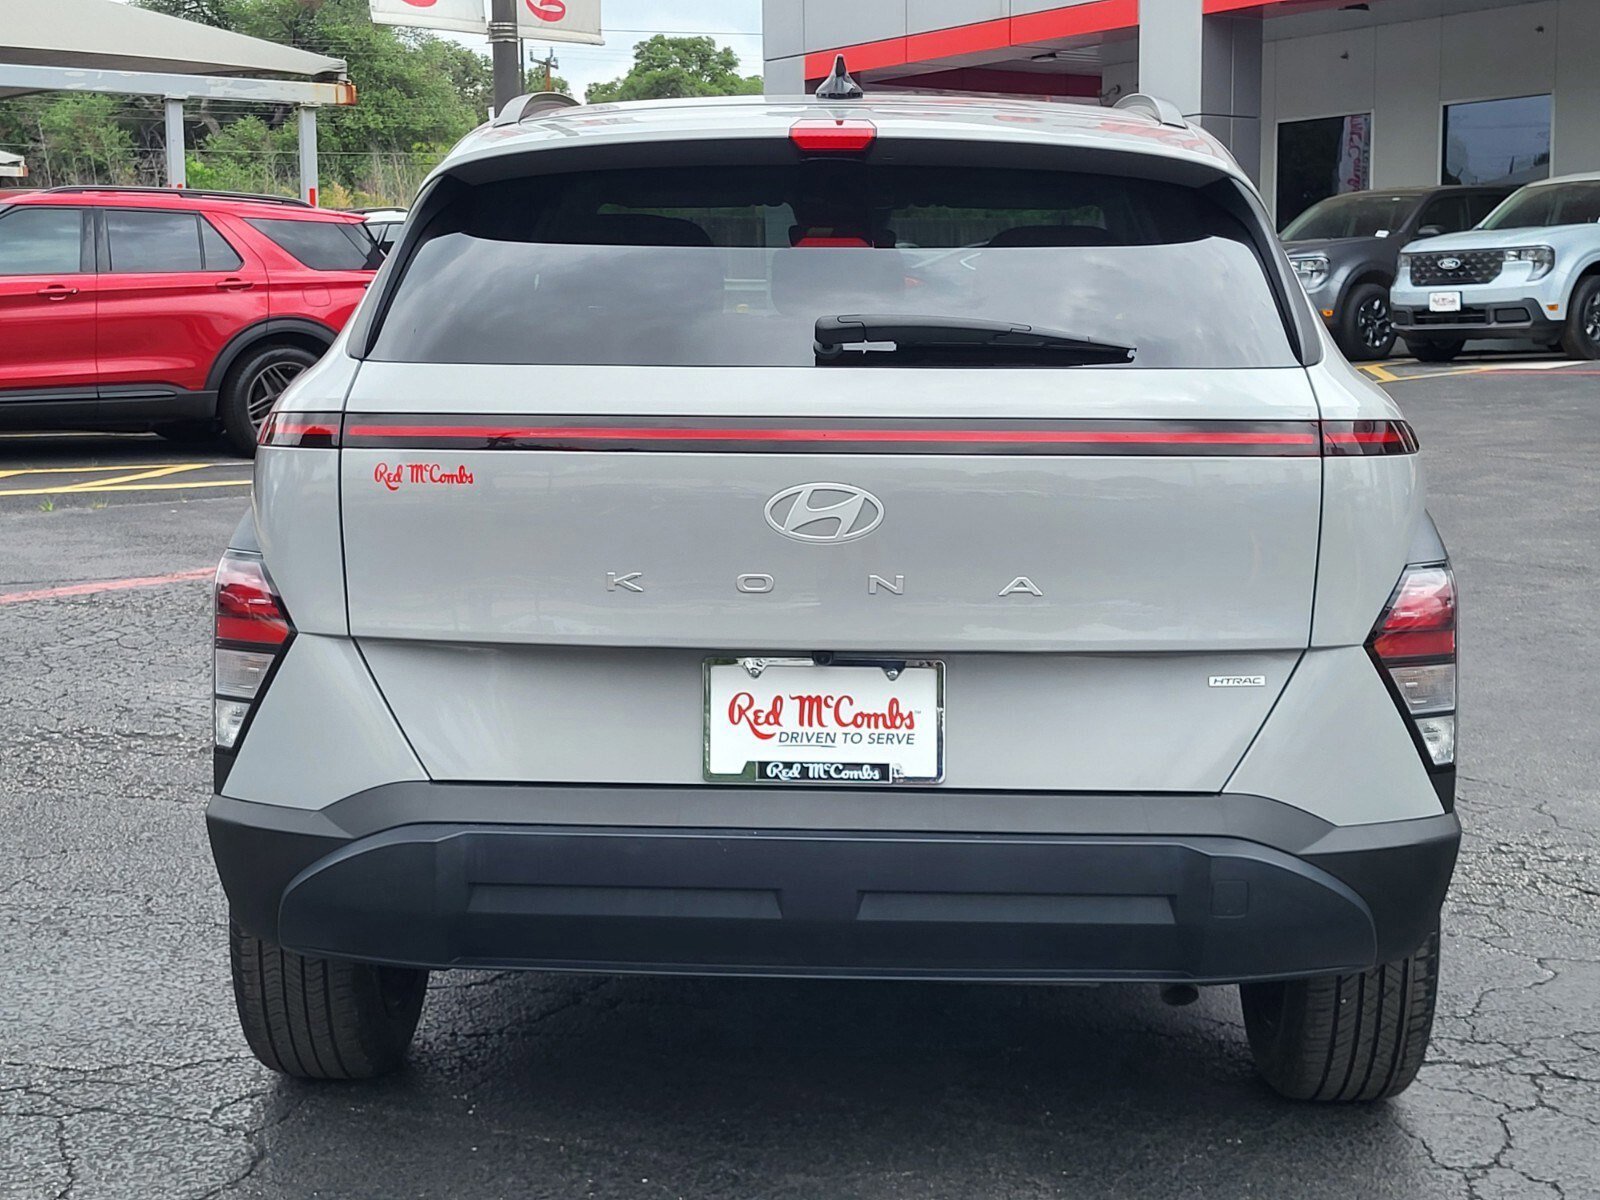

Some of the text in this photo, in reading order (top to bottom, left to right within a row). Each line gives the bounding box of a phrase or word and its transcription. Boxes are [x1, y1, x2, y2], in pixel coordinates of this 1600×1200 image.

[374, 462, 474, 491] Red McCombs
[1213, 677, 1262, 685] HTRAC
[728, 692, 783, 740] Red
[789, 694, 915, 730] McCombs
[778, 731, 916, 745] DRIVEN TO SERVE
[766, 762, 880, 780] Red McCombs
